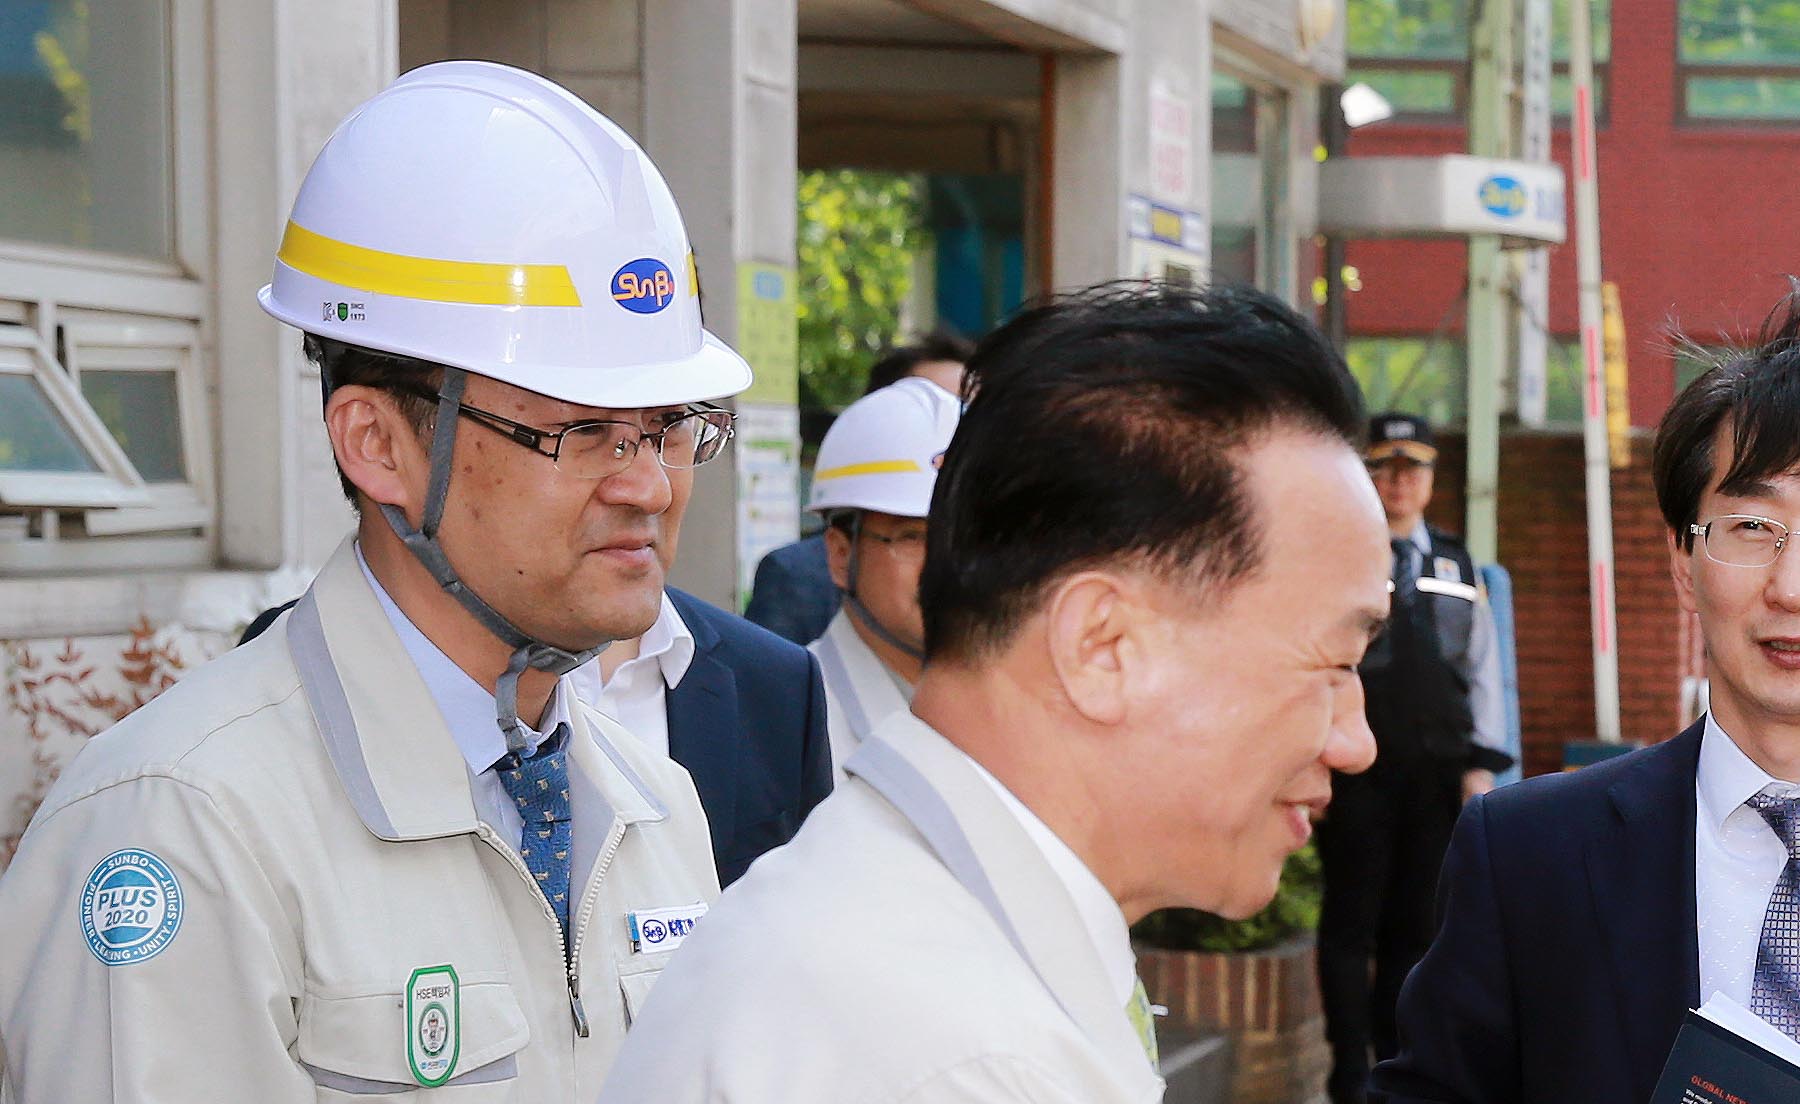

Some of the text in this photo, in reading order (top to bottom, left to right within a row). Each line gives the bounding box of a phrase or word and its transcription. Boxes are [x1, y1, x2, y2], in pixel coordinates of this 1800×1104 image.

[107, 855, 149, 869] SUNBO
[98, 888, 158, 912] PLUS
[161, 879, 178, 920] SPIRIT
[105, 909, 149, 927] 2020
[138, 926, 171, 955] UNITY
[1691, 1075, 1724, 1100] GLOBAL
